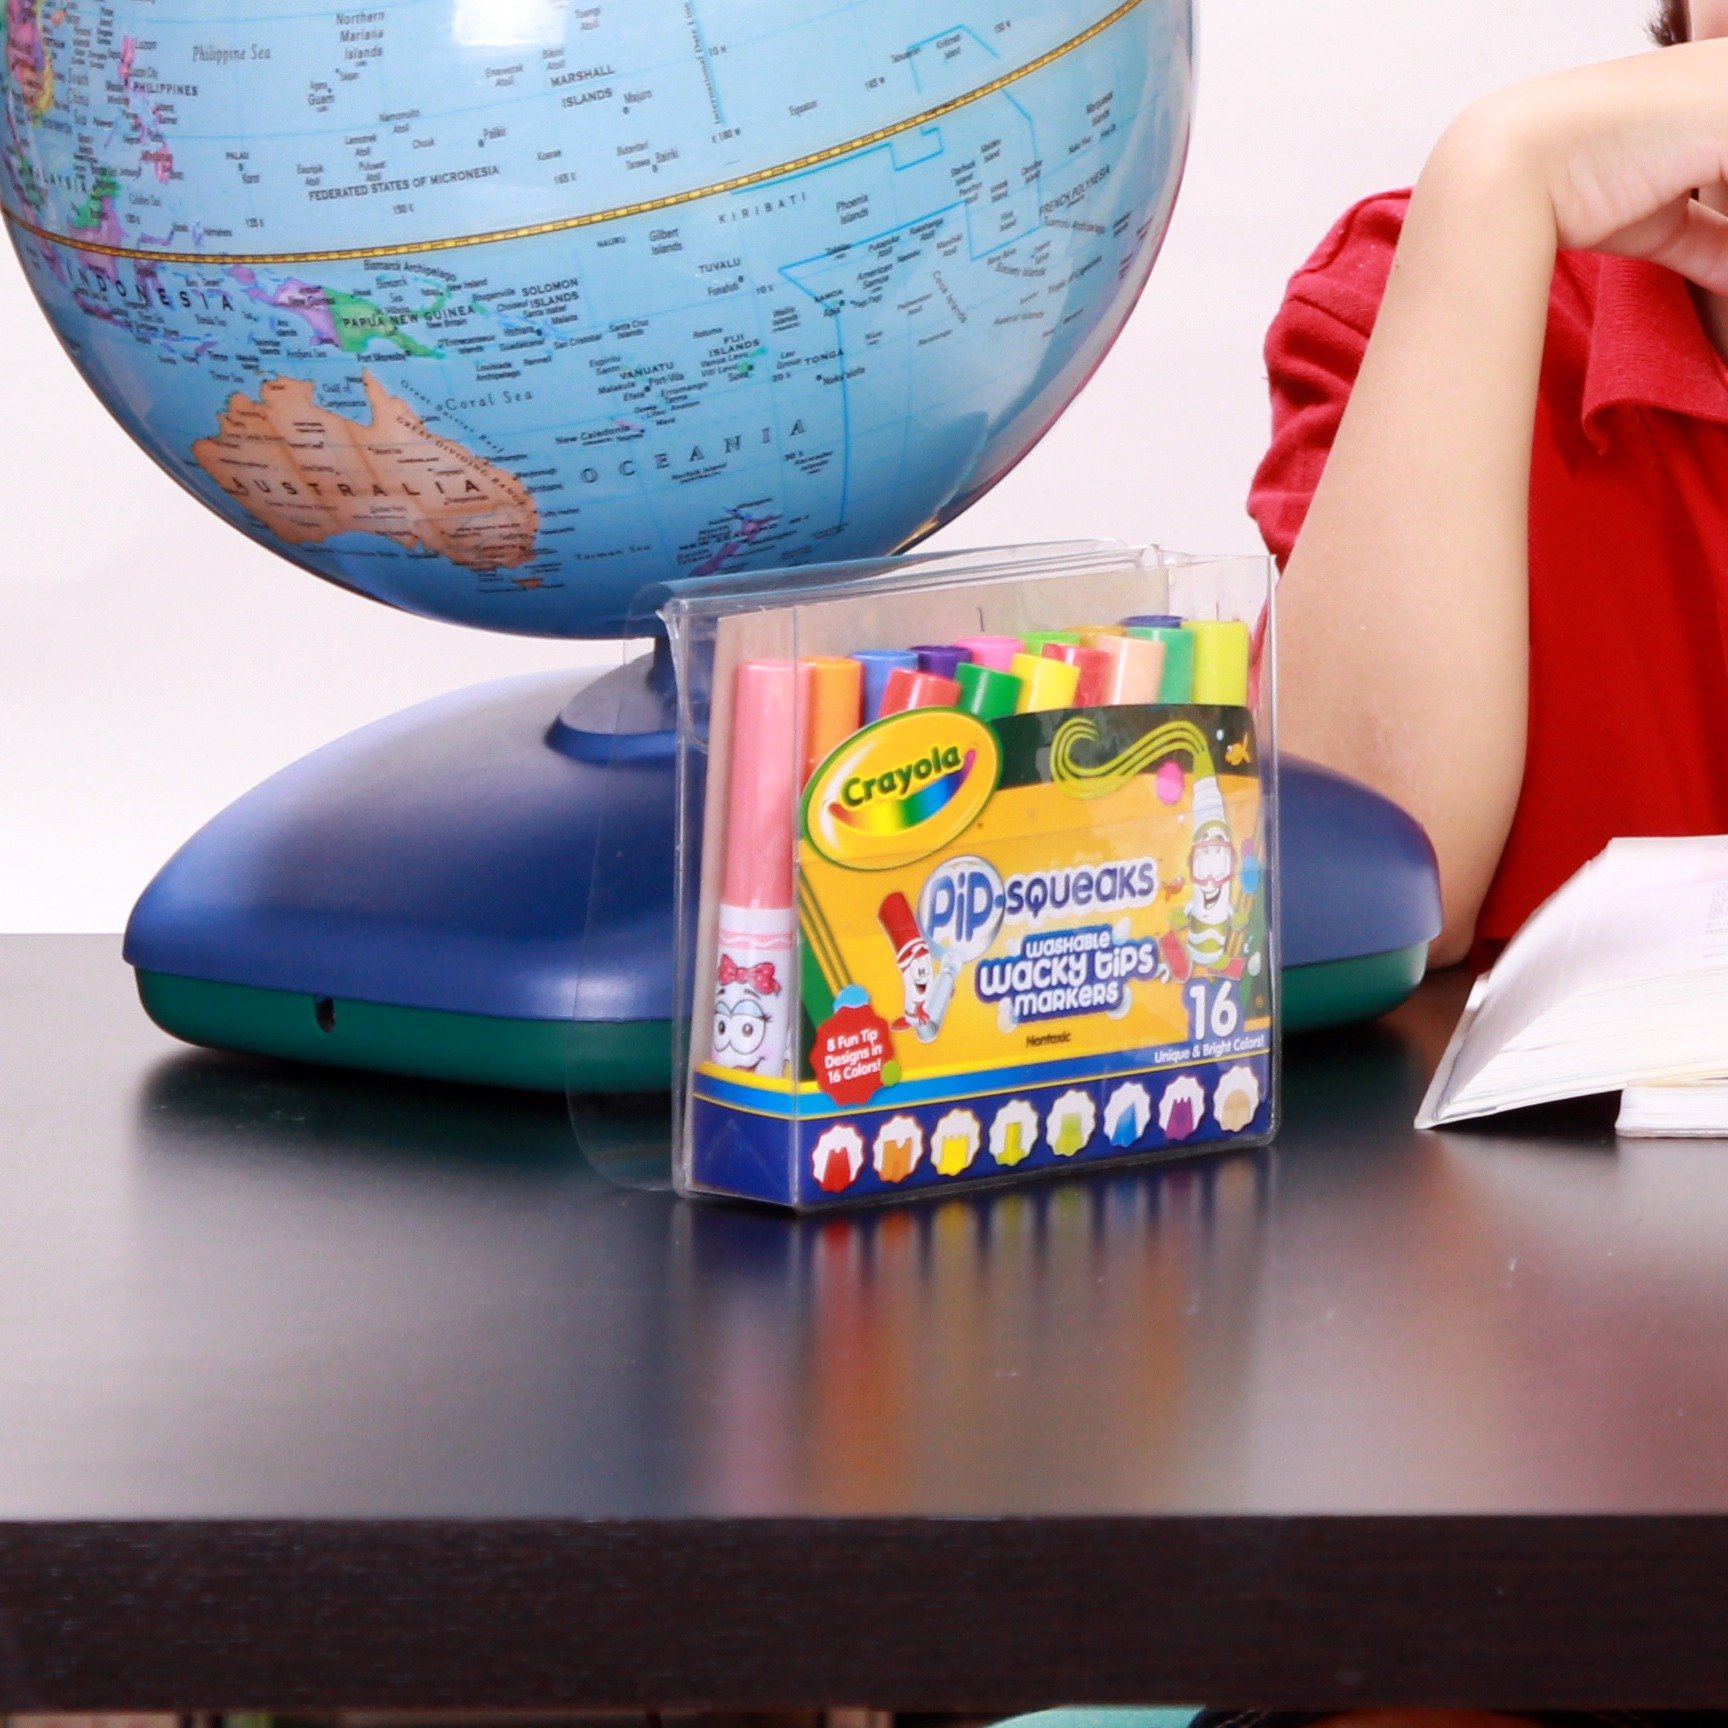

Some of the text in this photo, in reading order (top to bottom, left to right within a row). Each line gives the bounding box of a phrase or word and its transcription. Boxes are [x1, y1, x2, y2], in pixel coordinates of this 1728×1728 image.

[335, 10, 386, 26] Northern
[339, 28, 385, 43] Mariana
[549, 64, 616, 89] MARSHALL
[132, 81, 199, 98] PHILIPPINES
[561, 86, 614, 109] ISLANDS
[308, 165, 500, 202] FEDERATED STATES OF MICRONESIA
[718, 191, 808, 225] KIRIBATI
[596, 235, 627, 249] NAURU
[698, 257, 742, 274] TUVALU
[520, 278, 580, 298] SOLOMON
[529, 290, 580, 308] ISLANDS
[343, 304, 477, 329] PAPUA NEW GUINEA
[708, 338, 761, 359] ISLANDS
[722, 333, 746, 346] FIJI
[803, 348, 845, 367] TONGA
[618, 361, 675, 381] VANUATU
[445, 389, 535, 412] Coral Sea
[580, 418, 806, 484] OCEANIA
[231, 475, 482, 498] AUSTRALIA
[841, 745, 962, 807] Crayola
[1189, 979, 1238, 1041] 16
[826, 1028, 879, 1053] 8 Fun Tip
[1024, 1029, 1072, 1048] Nontoxic
[1154, 1034, 1265, 1063] Unique & Bright Colors!
[824, 1044, 883, 1070] Designs in
[827, 1057, 882, 1084] 16 Colors!
